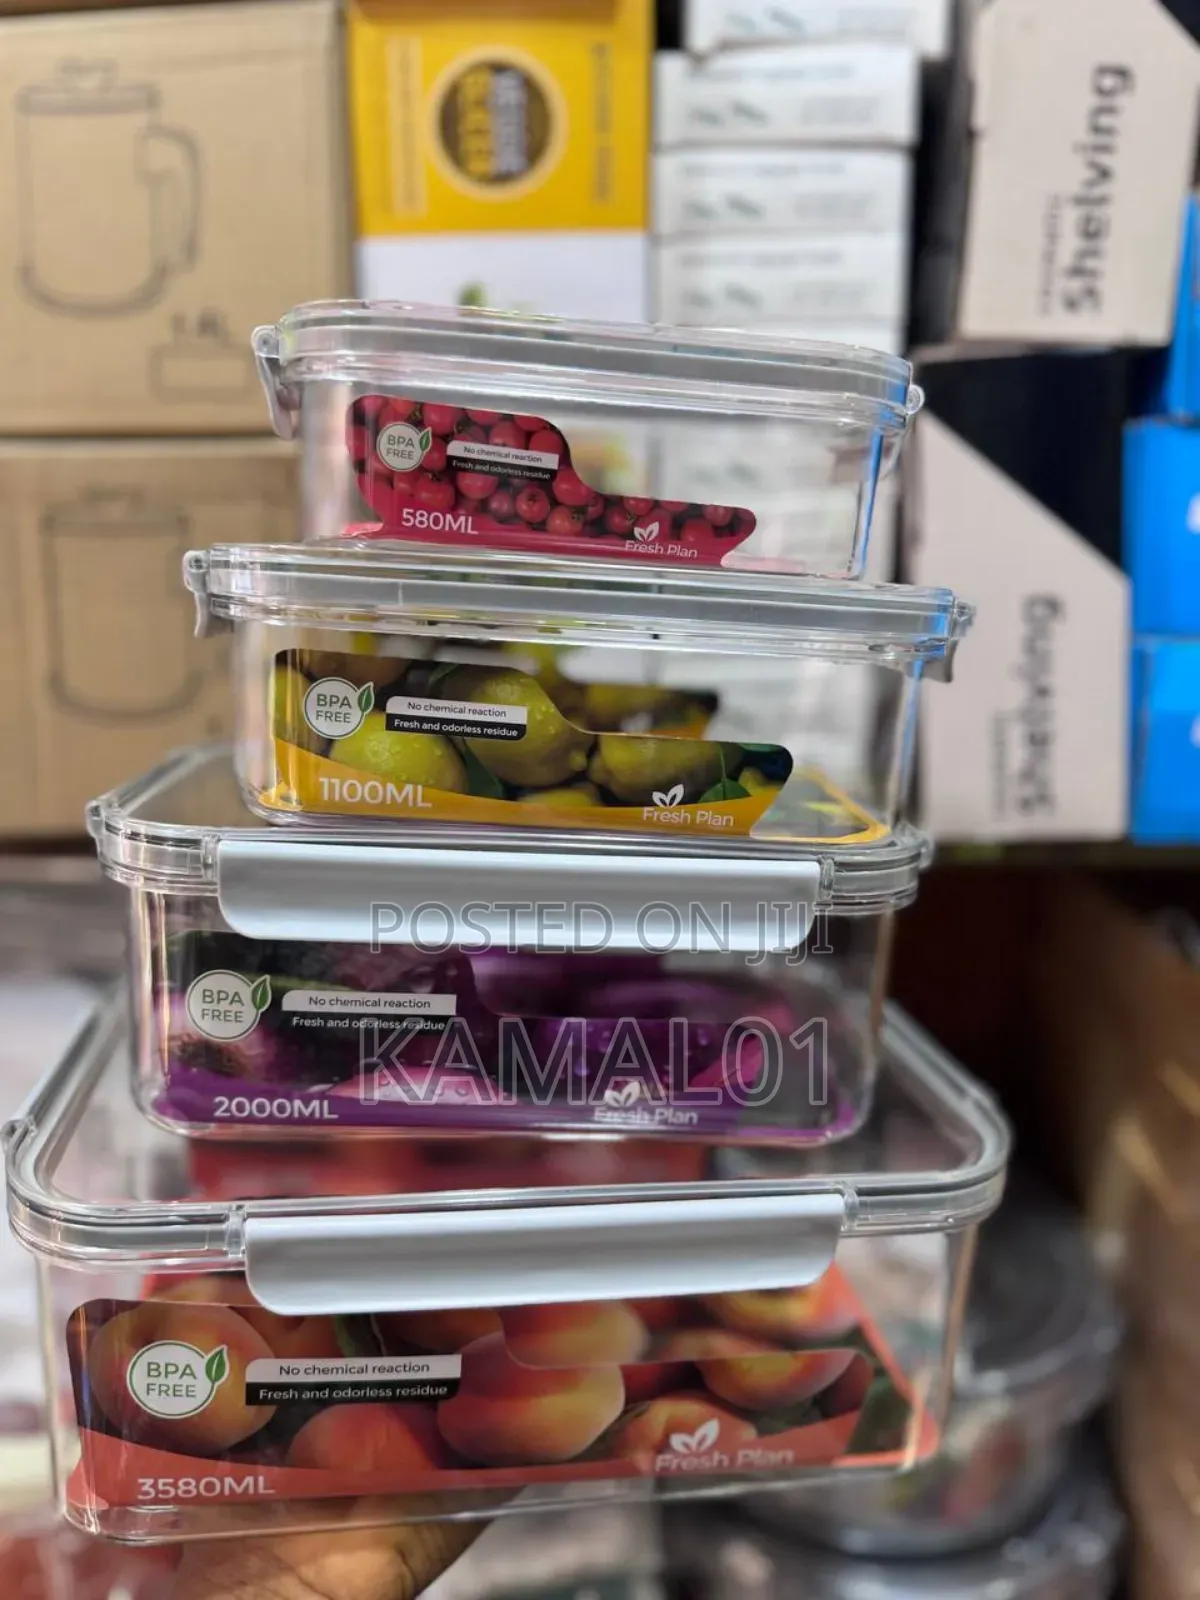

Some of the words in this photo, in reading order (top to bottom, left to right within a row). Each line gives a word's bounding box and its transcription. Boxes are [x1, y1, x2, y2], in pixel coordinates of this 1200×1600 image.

[1062, 62, 1135, 314] Shelving
[387, 433, 416, 449] BPA
[385, 447, 415, 460] FREE
[463, 446, 476, 456] No
[476, 447, 511, 461] chemical
[511, 453, 543, 464] reaction
[452, 459, 474, 471] Fresh
[475, 463, 490, 473] and
[490, 464, 523, 478] odorless
[523, 469, 551, 480] residue
[401, 508, 479, 535] 580ML
[624, 539, 664, 556] Fresh
[667, 543, 698, 559] Plan
[315, 693, 352, 710] BPA
[407, 701, 422, 712] No
[422, 702, 467, 716] chemical
[467, 705, 507, 718] reaction
[315, 709, 352, 724] FREE
[393, 719, 420, 731] Fresh
[421, 720, 440, 732] and
[441, 722, 482, 736] odorless
[483, 726, 519, 738] residue
[319, 777, 433, 808] 1100ML
[642, 807, 691, 825] Fresh
[695, 810, 735, 827] Plan
[201, 988, 245, 1007] BPA
[308, 996, 326, 1006] No
[328, 996, 381, 1009] chemical
[383, 998, 431, 1010] reaction
[201, 1007, 243, 1024] FREE
[291, 1016, 325, 1028] Fresh
[326, 1017, 350, 1029] and
[352, 1017, 401, 1030] odorless
[403, 1019, 446, 1031] residue
[213, 1096, 339, 1120] 2000ML
[594, 1106, 650, 1123] Fresh
[654, 1107, 699, 1124] Plan
[146, 1361, 197, 1381] BPA
[279, 1364, 301, 1376] No
[303, 1363, 369, 1376] chemical
[371, 1361, 430, 1375] reaction
[145, 1383, 197, 1398] FREE
[259, 1387, 299, 1400] Fresh
[301, 1386, 330, 1399] and
[332, 1385, 393, 1399] odorless
[395, 1384, 448, 1397] residue
[654, 1451, 730, 1472] Fresh
[737, 1449, 796, 1467] Plan
[136, 1475, 275, 1500] 3580ML
